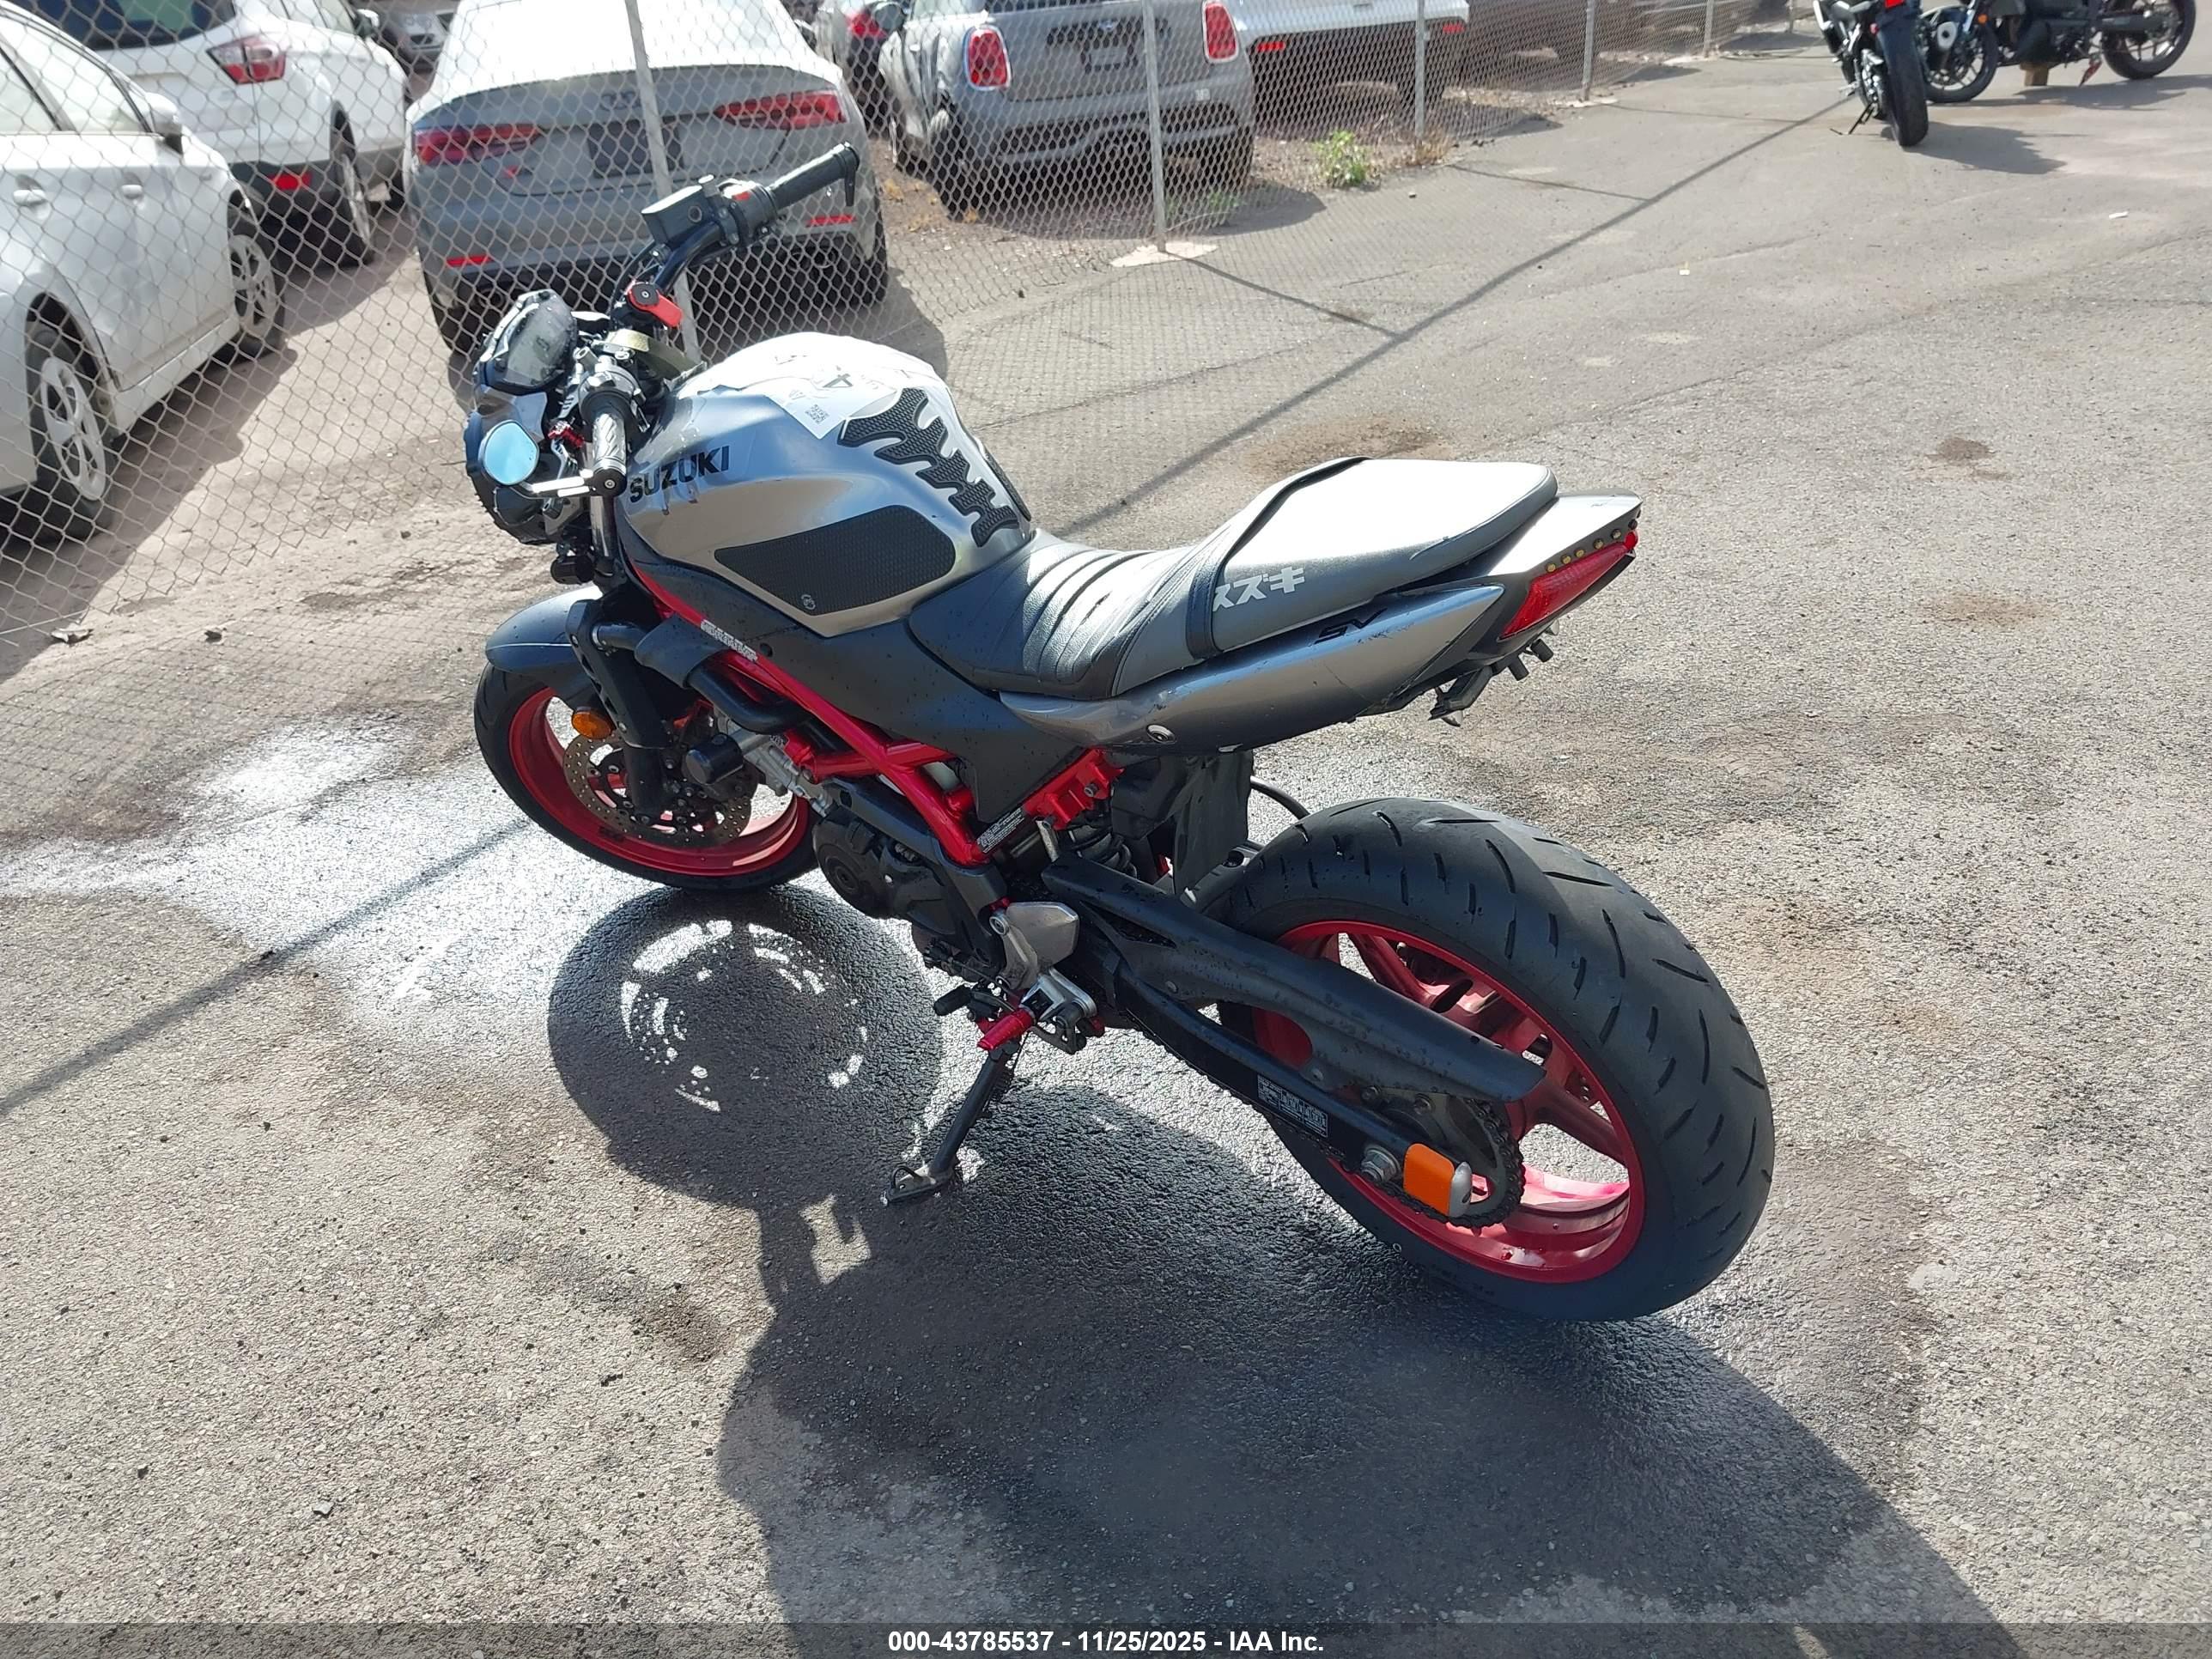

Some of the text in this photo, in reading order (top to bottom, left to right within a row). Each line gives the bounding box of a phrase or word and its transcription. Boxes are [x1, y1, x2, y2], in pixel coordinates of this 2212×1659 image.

[629, 446, 730, 503] SUZUKI
[1212, 567, 1305, 611] スズキ
